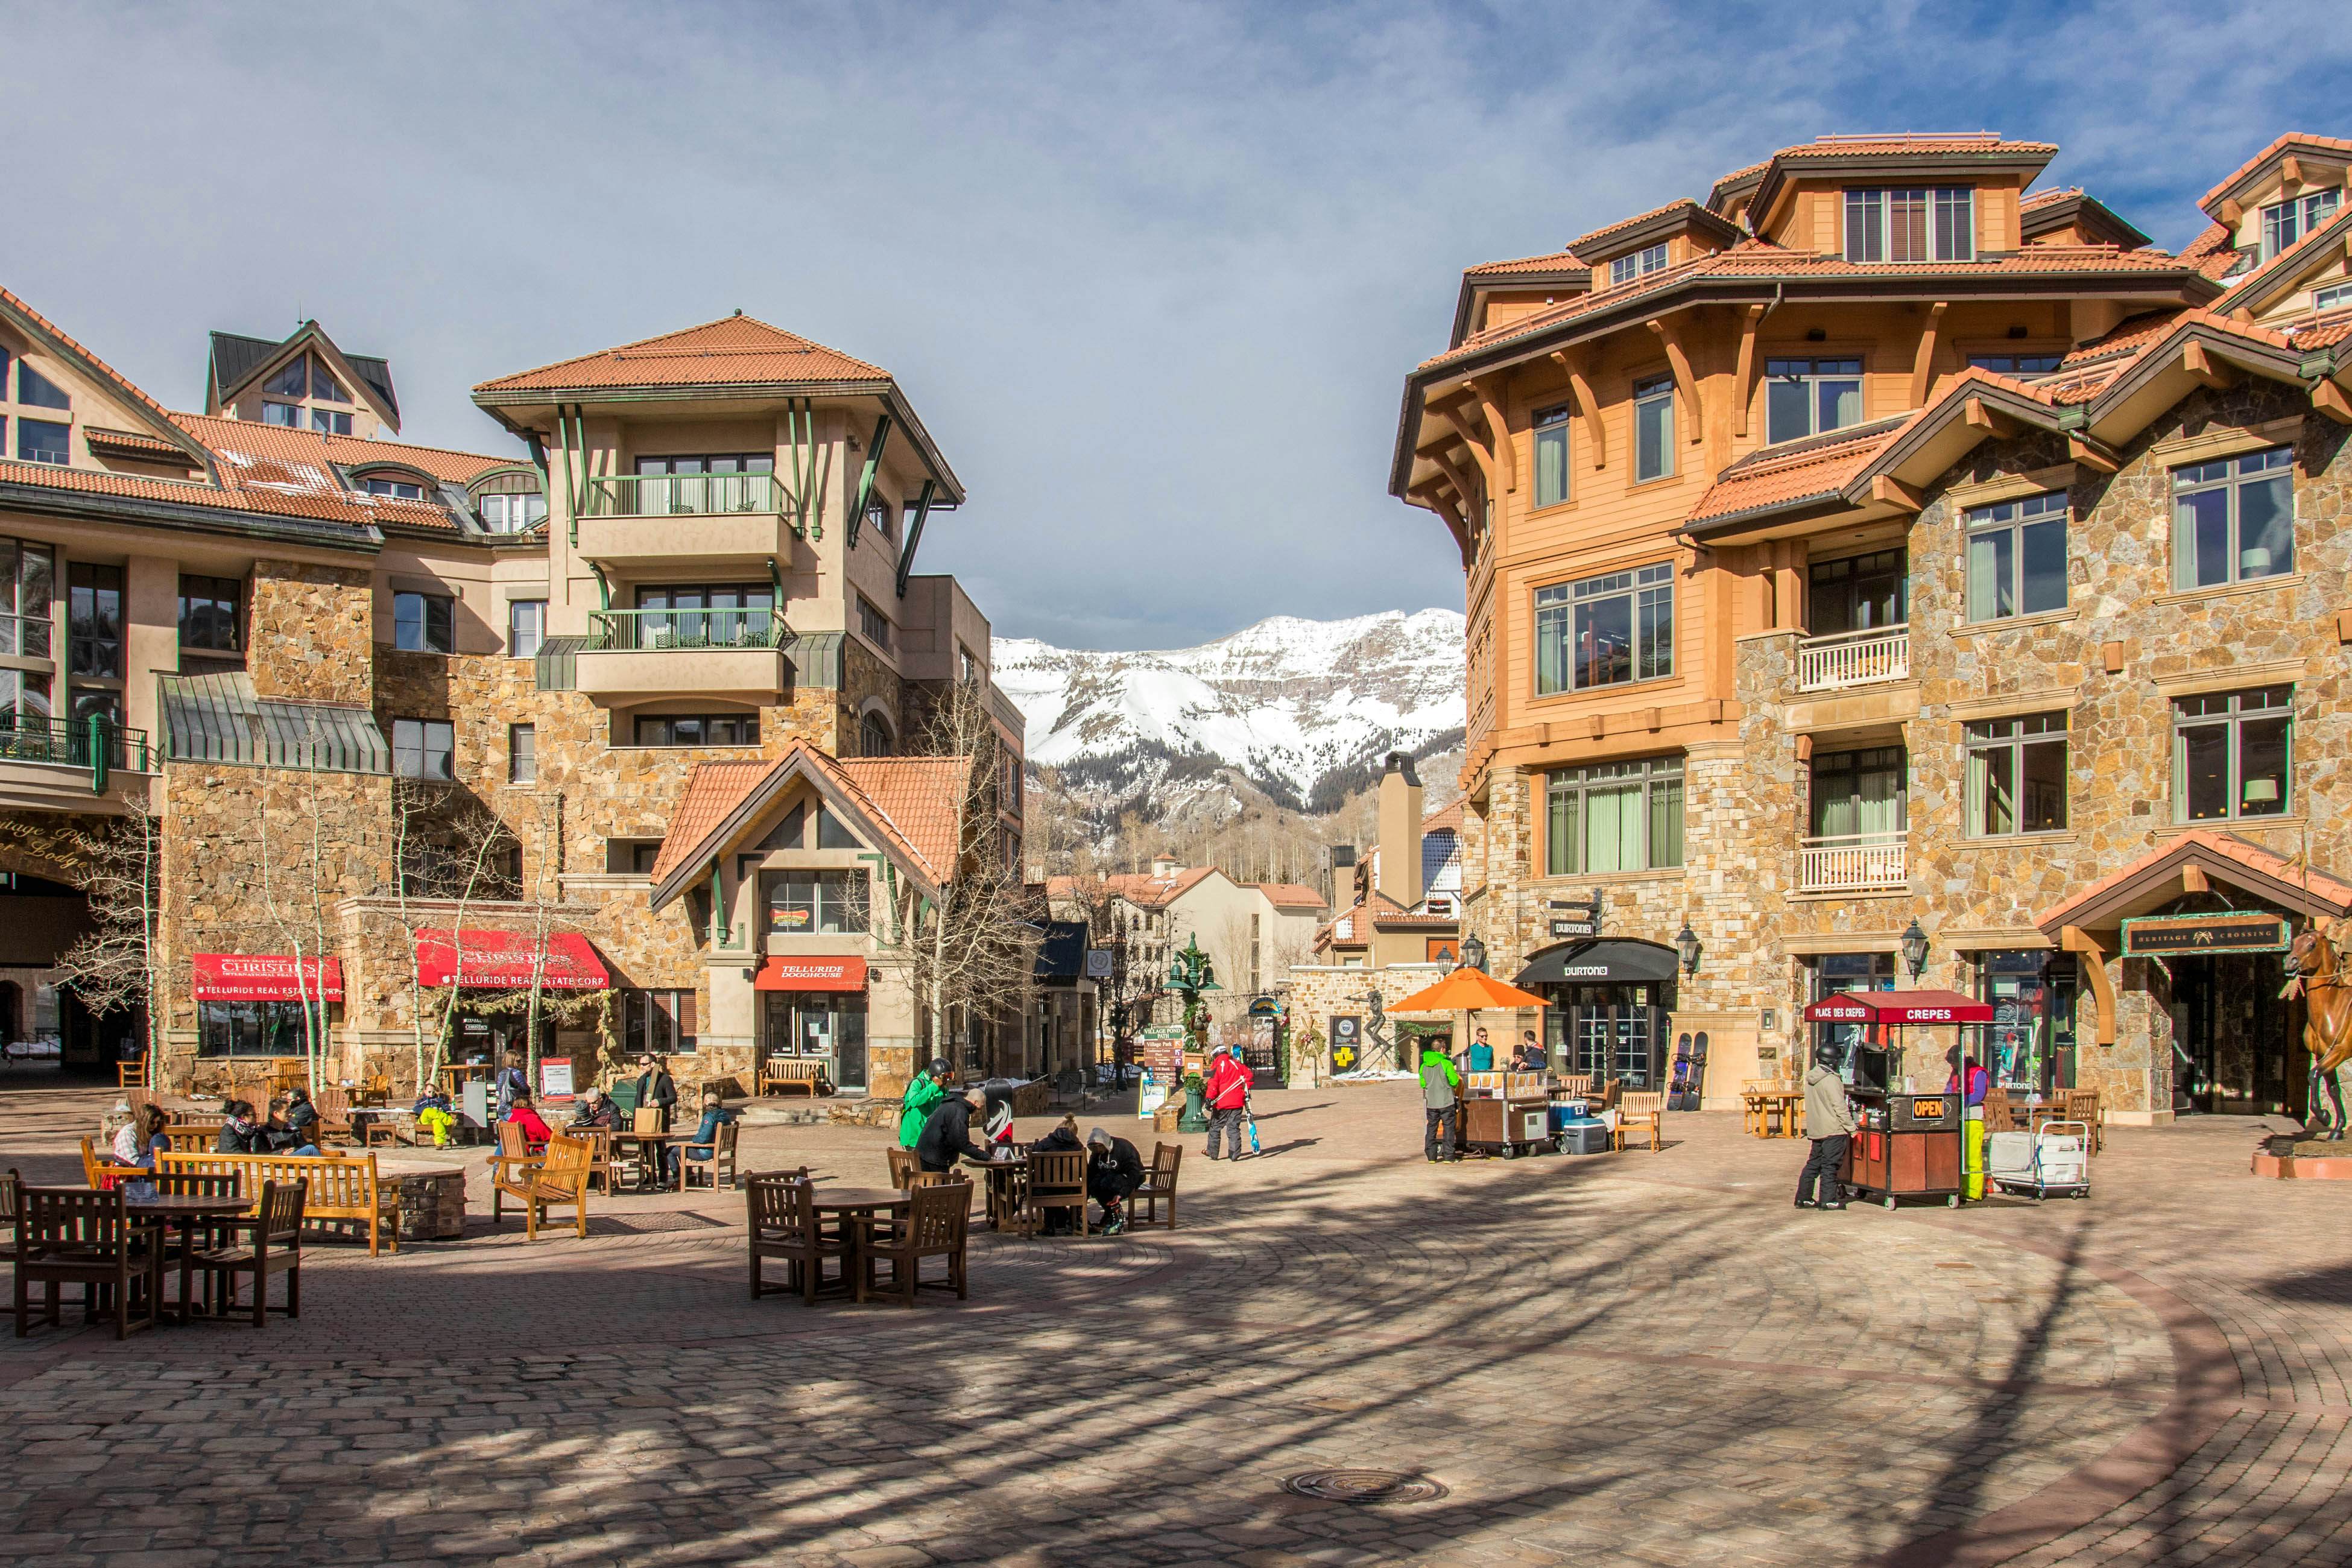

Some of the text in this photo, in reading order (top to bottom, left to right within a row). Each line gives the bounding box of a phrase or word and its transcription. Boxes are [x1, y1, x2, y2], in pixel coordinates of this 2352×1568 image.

[24, 841, 87, 868] Lodge
[1555, 923, 1584, 933] BURTON
[1564, 966, 1599, 976] BURTON
[577, 977, 606, 985] CORP.
[1815, 1008, 1865, 1017] PLACE DES CREPES
[1907, 1009, 1951, 1019] CREPES
[1914, 1101, 1943, 1116] OPEN
